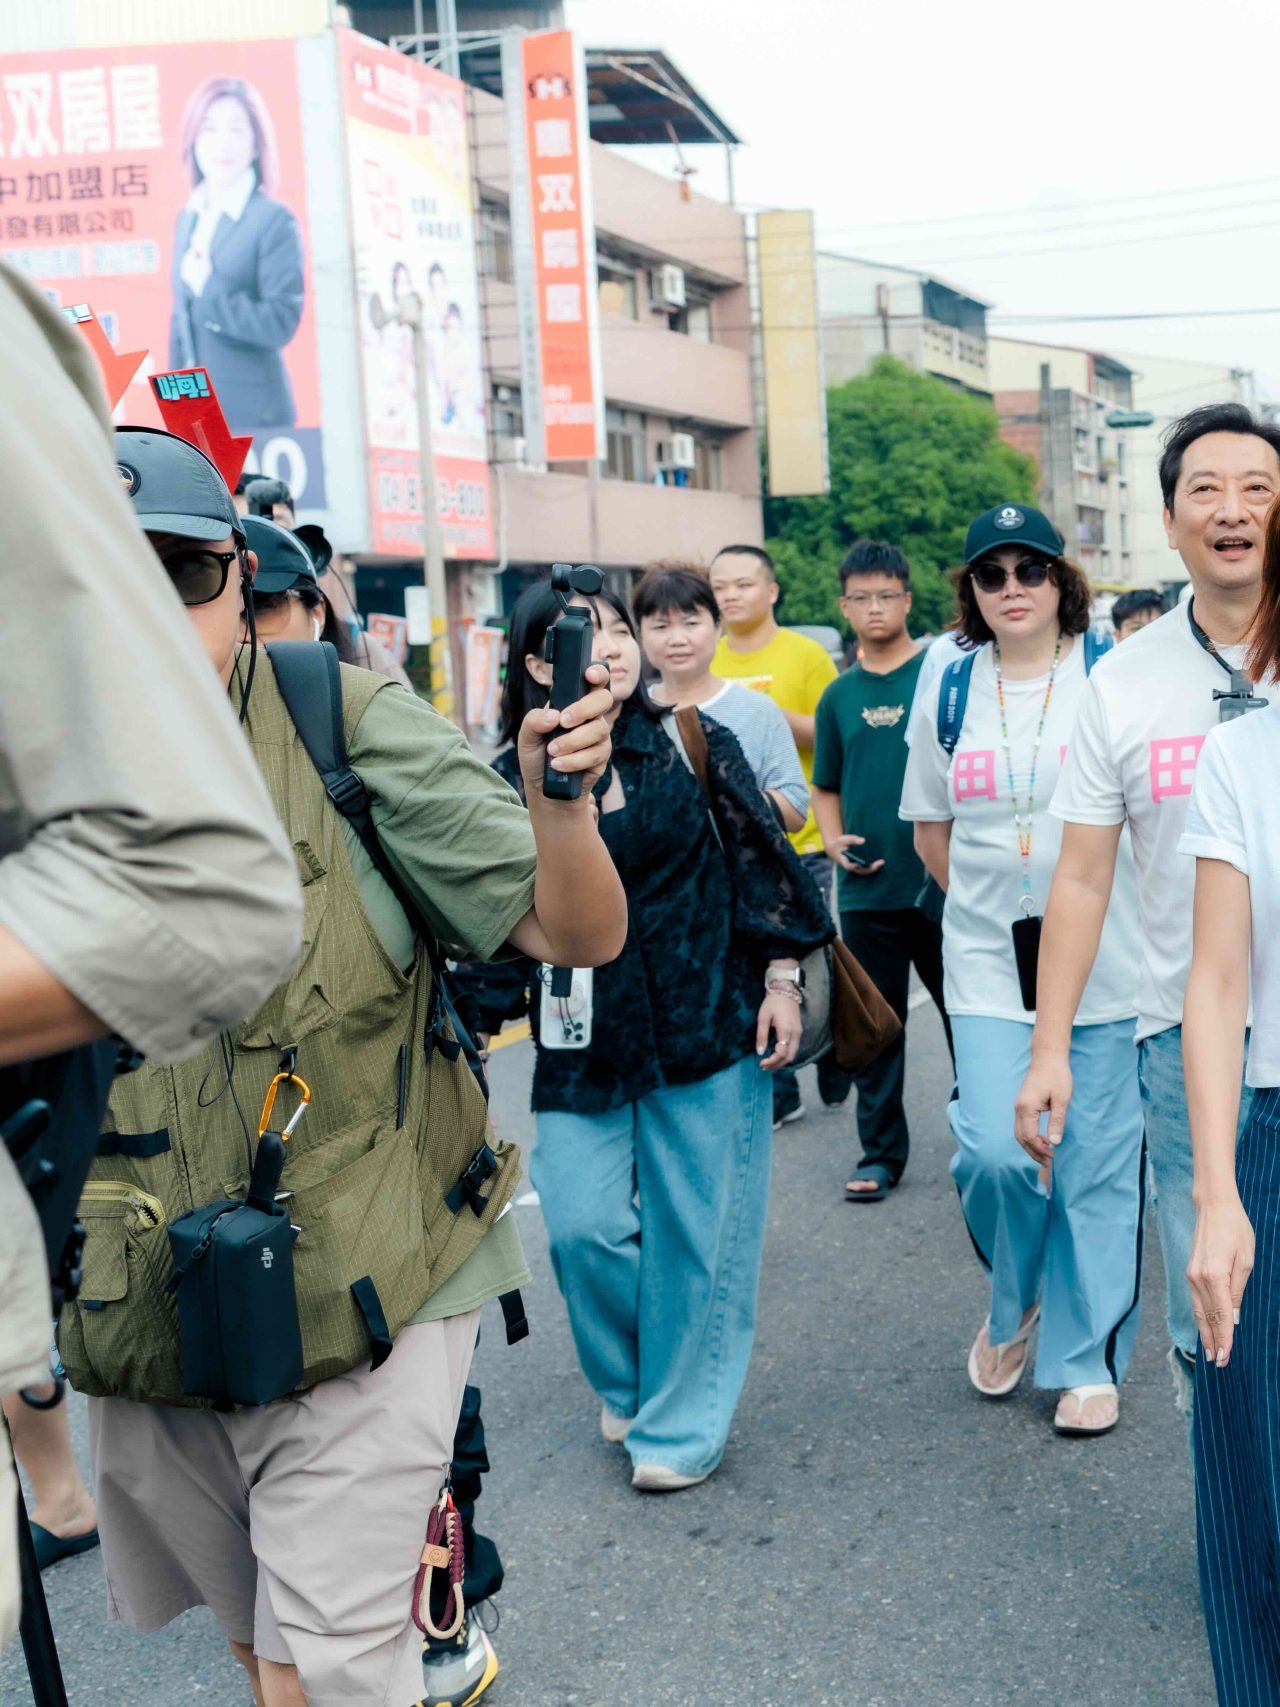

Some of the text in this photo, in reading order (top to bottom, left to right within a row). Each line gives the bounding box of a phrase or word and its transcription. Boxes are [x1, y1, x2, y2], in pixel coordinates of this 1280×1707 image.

[0, 64, 163, 159] 双房屋
[0, 208, 135, 240] 發有限公司
[953, 750, 998, 803] 田
